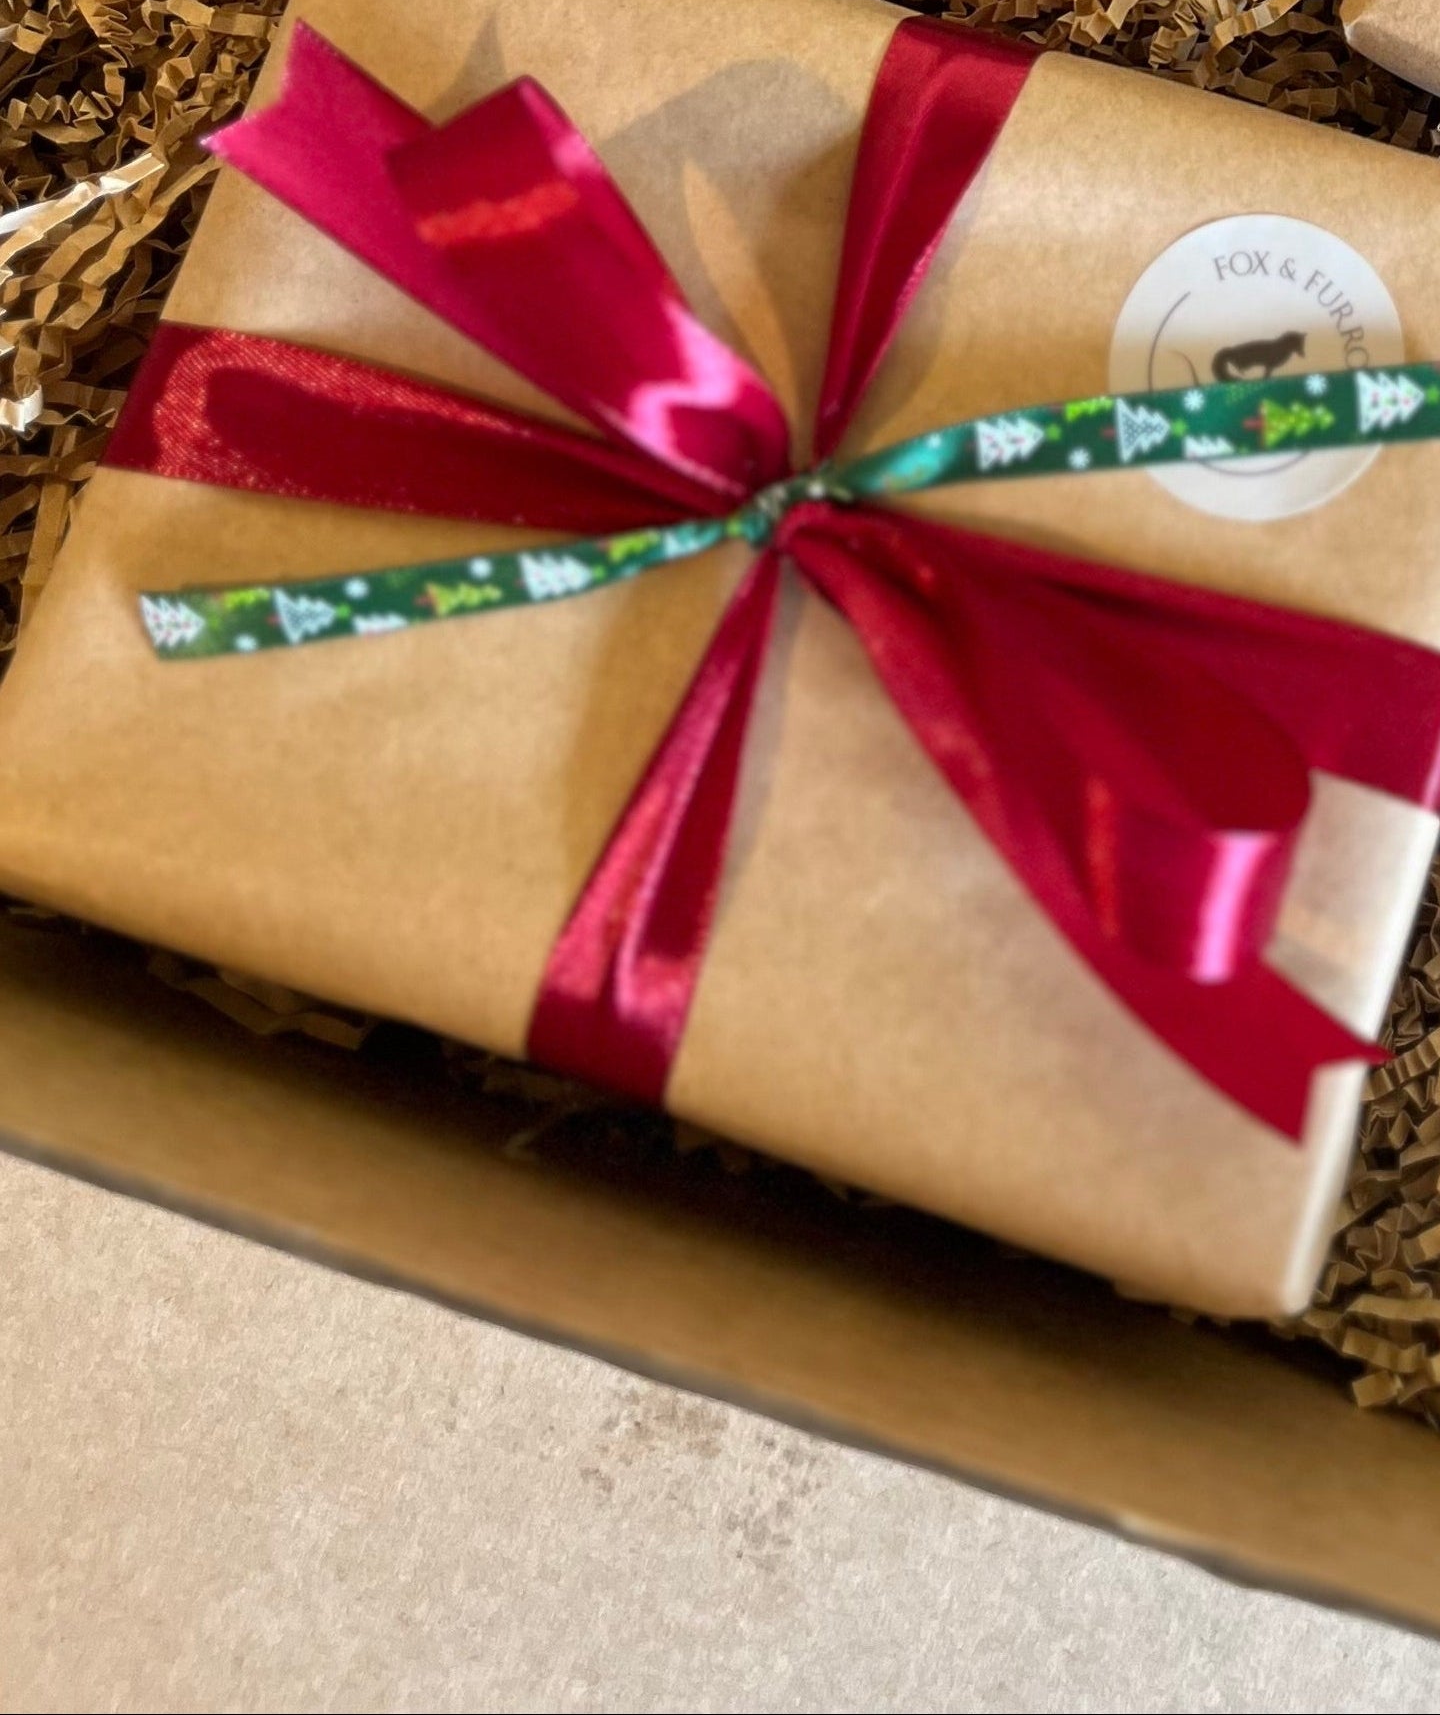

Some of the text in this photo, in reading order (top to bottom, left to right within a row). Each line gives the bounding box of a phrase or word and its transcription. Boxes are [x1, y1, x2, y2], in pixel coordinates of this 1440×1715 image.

[1211, 250, 1370, 370] FOX & FURRO
